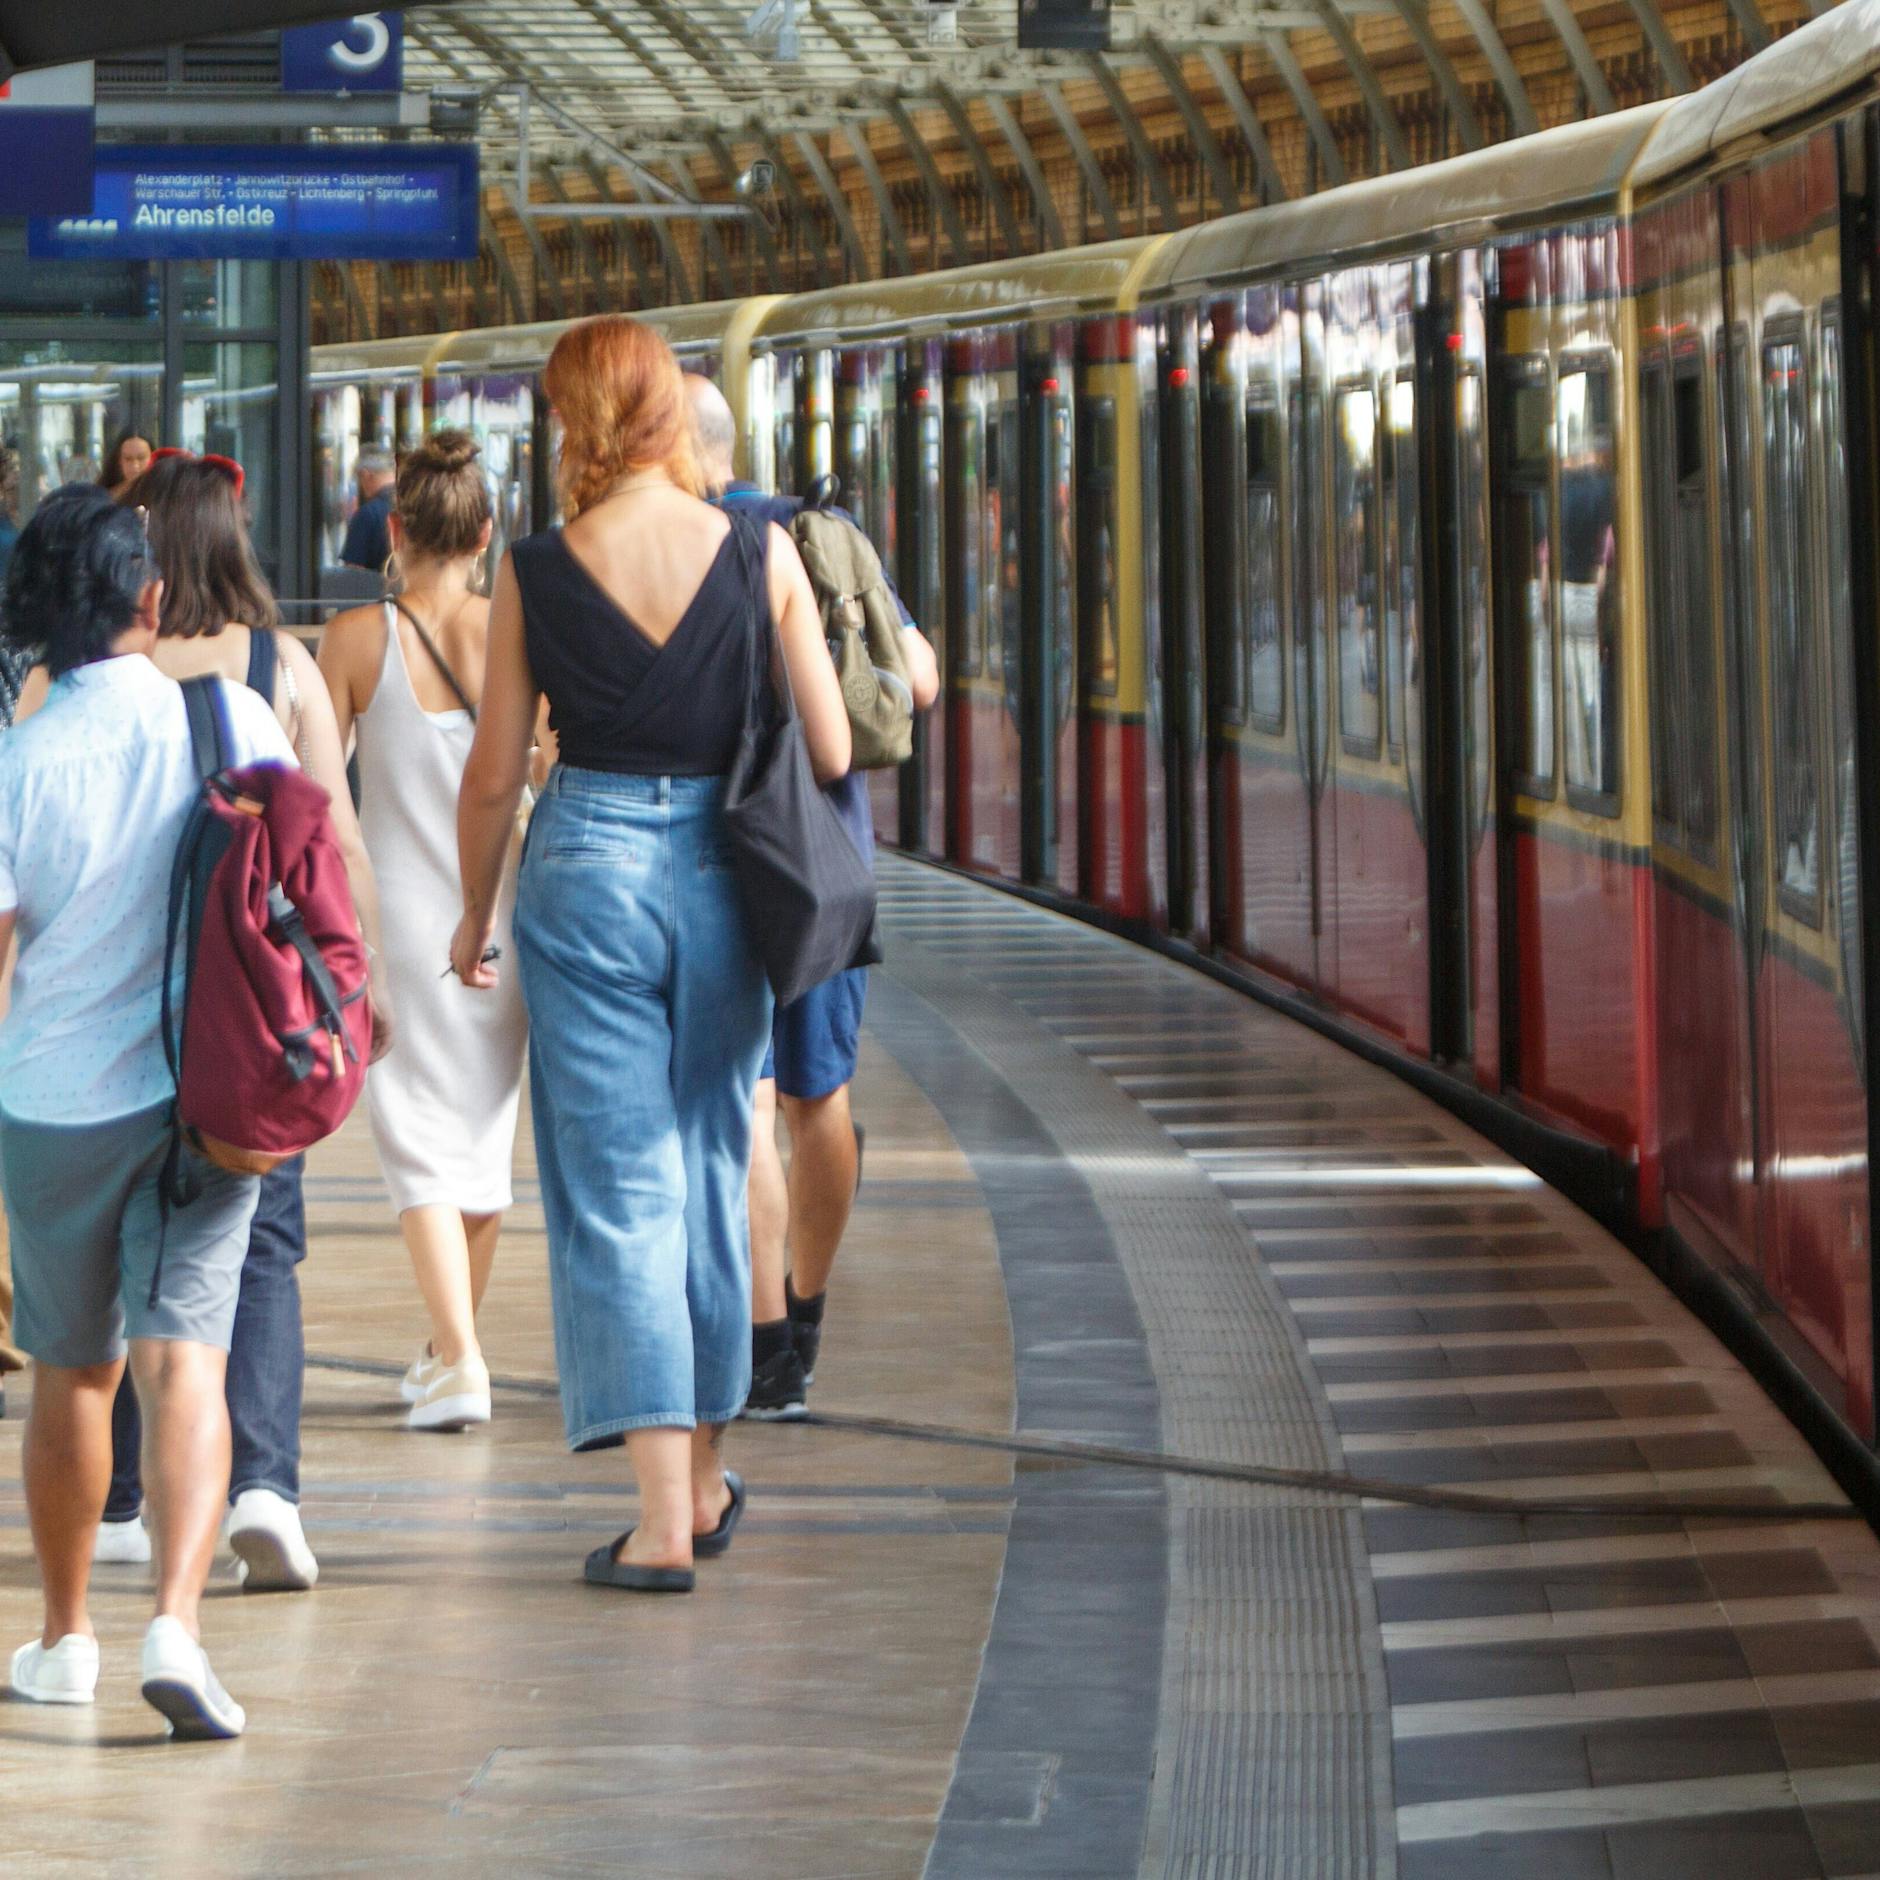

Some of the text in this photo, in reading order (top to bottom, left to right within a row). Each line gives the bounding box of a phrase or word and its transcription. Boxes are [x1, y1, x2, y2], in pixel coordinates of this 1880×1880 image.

[332, 12, 389, 65] 3
[135, 173, 222, 186] Alexanderplatz
[135, 203, 275, 224] Ahrensfelde
